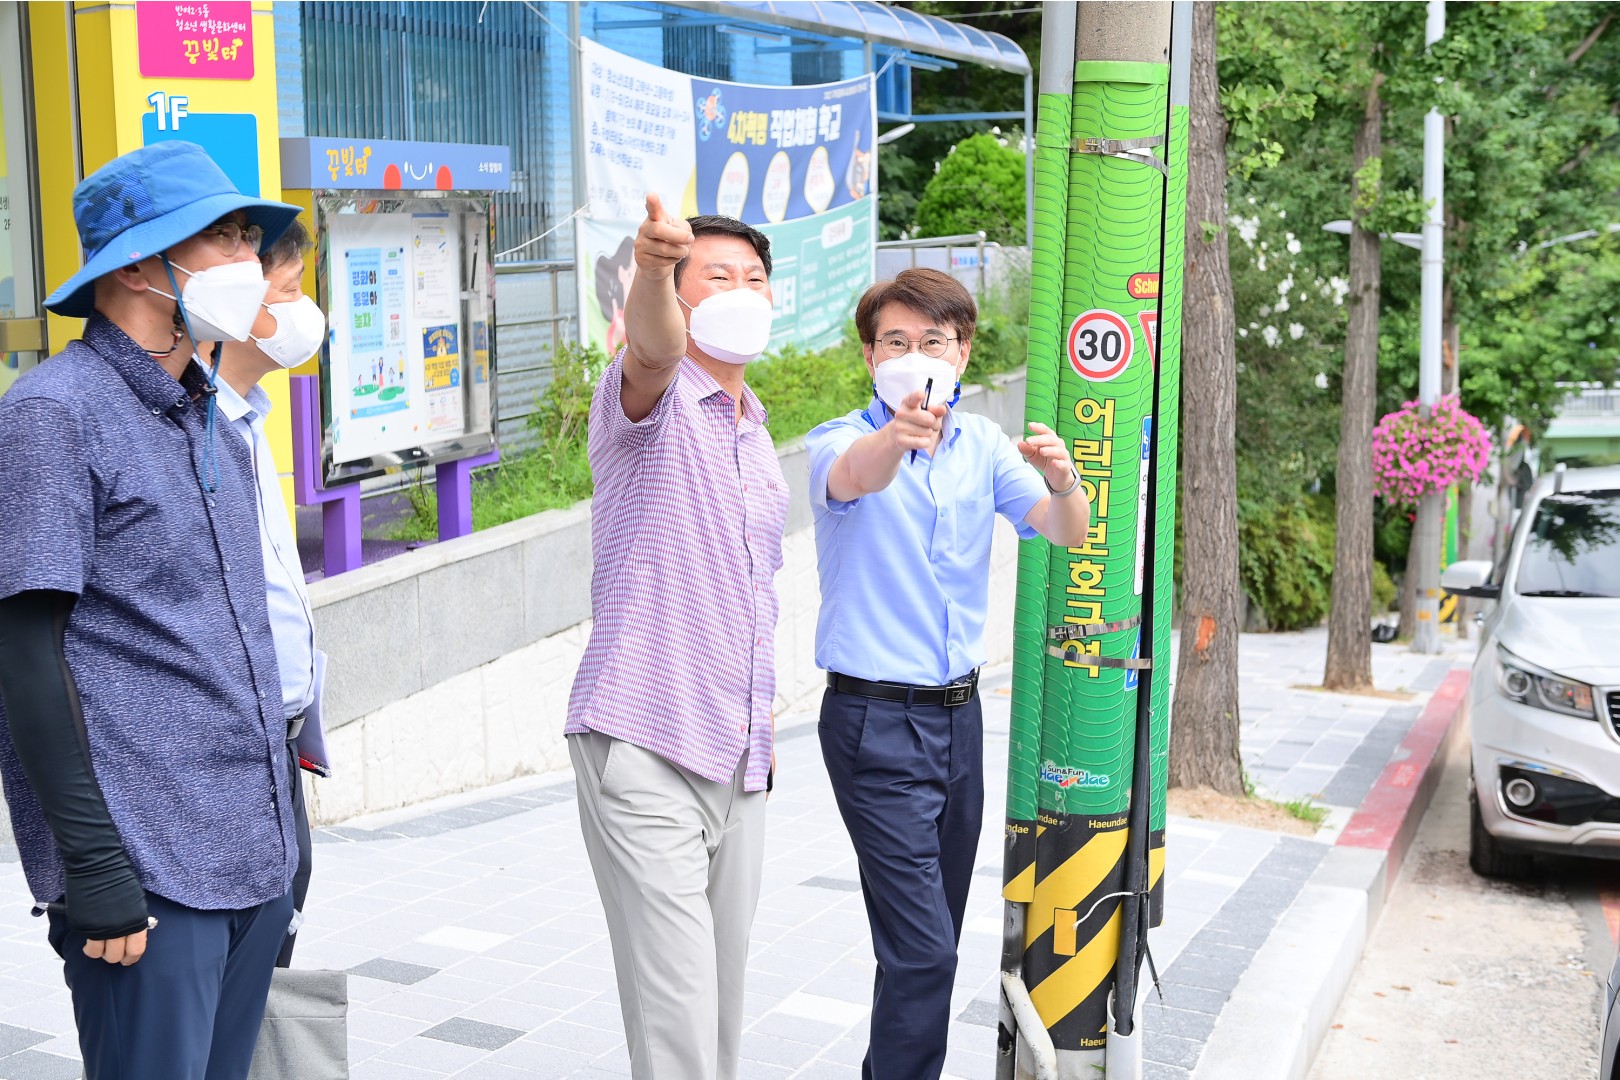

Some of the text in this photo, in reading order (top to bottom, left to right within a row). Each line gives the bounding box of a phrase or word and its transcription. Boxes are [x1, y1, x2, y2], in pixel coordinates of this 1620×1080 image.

[175, 18, 246, 35] 청소년 생활문화센터
[147, 91, 188, 131] 1F
[818, 103, 842, 142] 학교
[1078, 329, 1122, 362] 30
[1047, 764, 1085, 776] Sun&Fun
[1088, 816, 1128, 830] Haeundae
